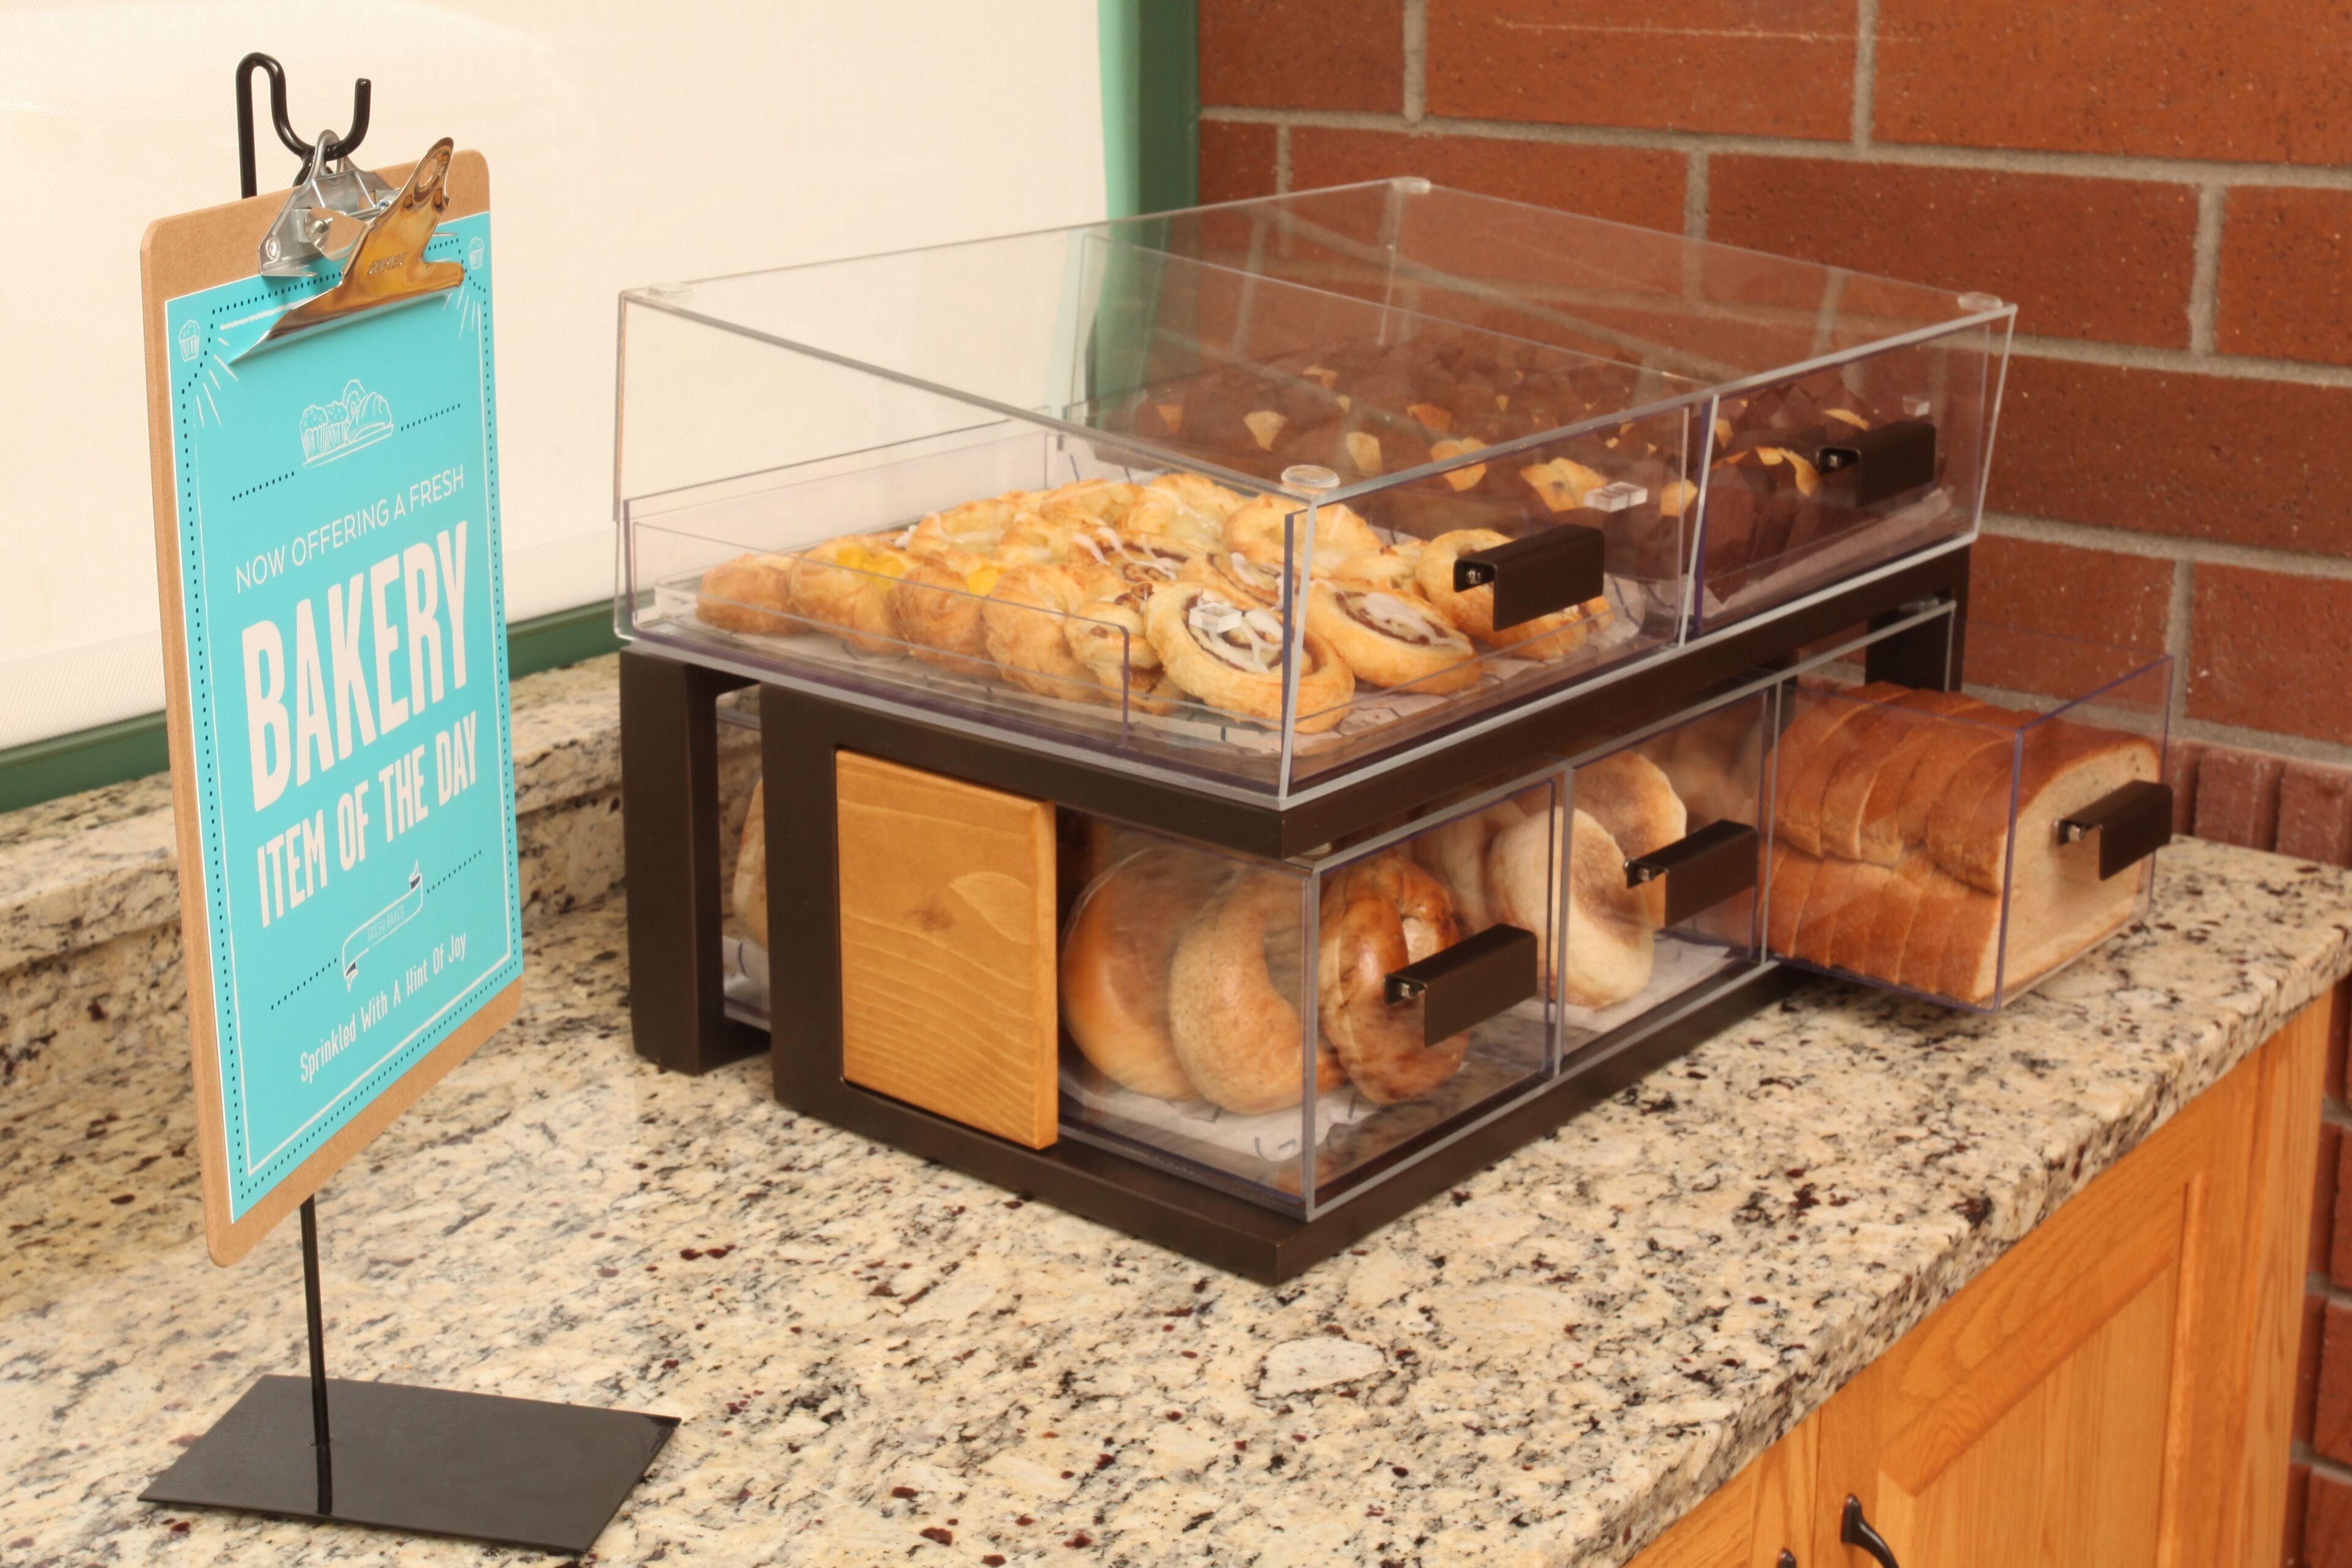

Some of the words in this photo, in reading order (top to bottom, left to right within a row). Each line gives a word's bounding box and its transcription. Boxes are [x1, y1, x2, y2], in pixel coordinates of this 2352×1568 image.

[235, 544, 285, 594] NOW
[292, 499, 389, 566] OFFERING
[394, 493, 406, 520] A
[409, 464, 464, 513] FRESH
[241, 520, 467, 812] BAKERY
[257, 808, 328, 929] ITEM
[337, 778, 369, 872] OF
[378, 743, 429, 843] THE
[435, 710, 477, 807] DAY
[368, 919, 386, 943] FRESH
[386, 904, 405, 929] BAKED
[300, 1012, 356, 1084] Sprinkled
[360, 990, 388, 1033] With
[393, 979, 401, 1008] A
[405, 958, 428, 998] Hint
[432, 943, 444, 975] Of
[448, 932, 466, 963] Joy
